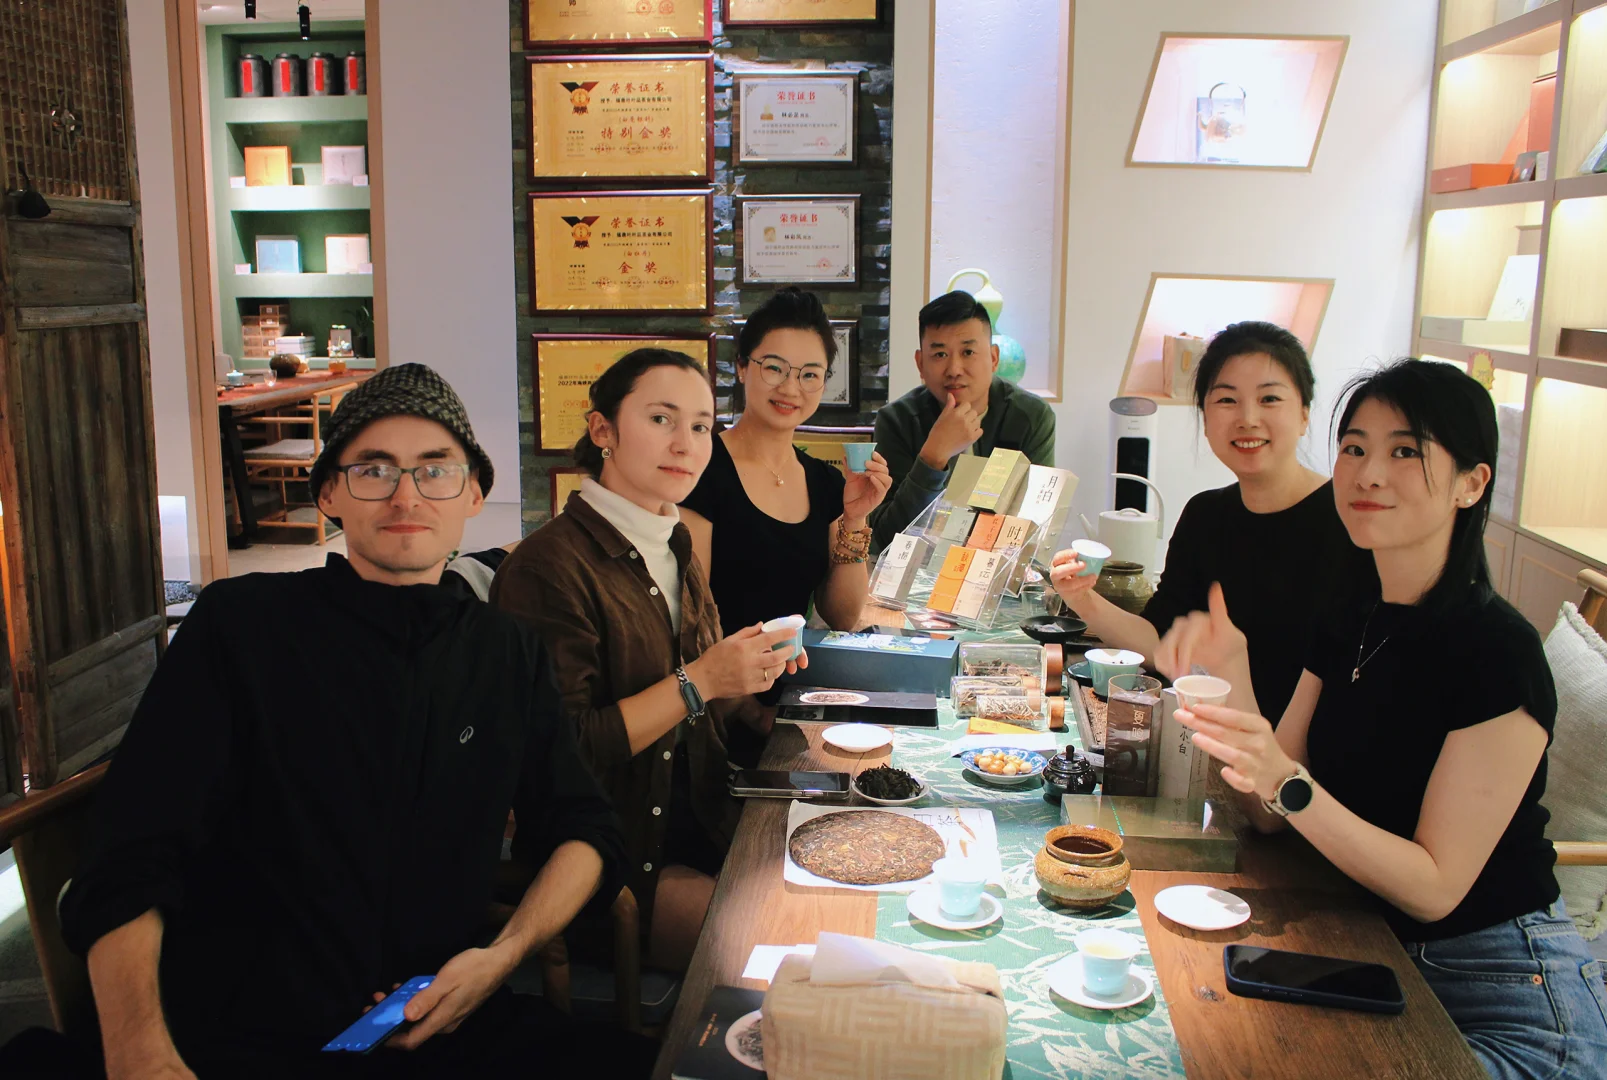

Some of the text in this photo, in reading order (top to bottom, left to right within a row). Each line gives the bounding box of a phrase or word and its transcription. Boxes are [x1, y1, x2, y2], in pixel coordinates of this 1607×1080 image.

[609, 82, 665, 94] 荣誉证书
[776, 91, 817, 101] 荣誉证书
[601, 125, 672, 140] 特别金奖
[609, 216, 665, 229] 荣誉证书
[779, 213, 819, 223] 荣誉证书
[617, 261, 658, 274] 金奖
[1041, 475, 1059, 503] 月白
[1178, 724, 1189, 754] 小白
